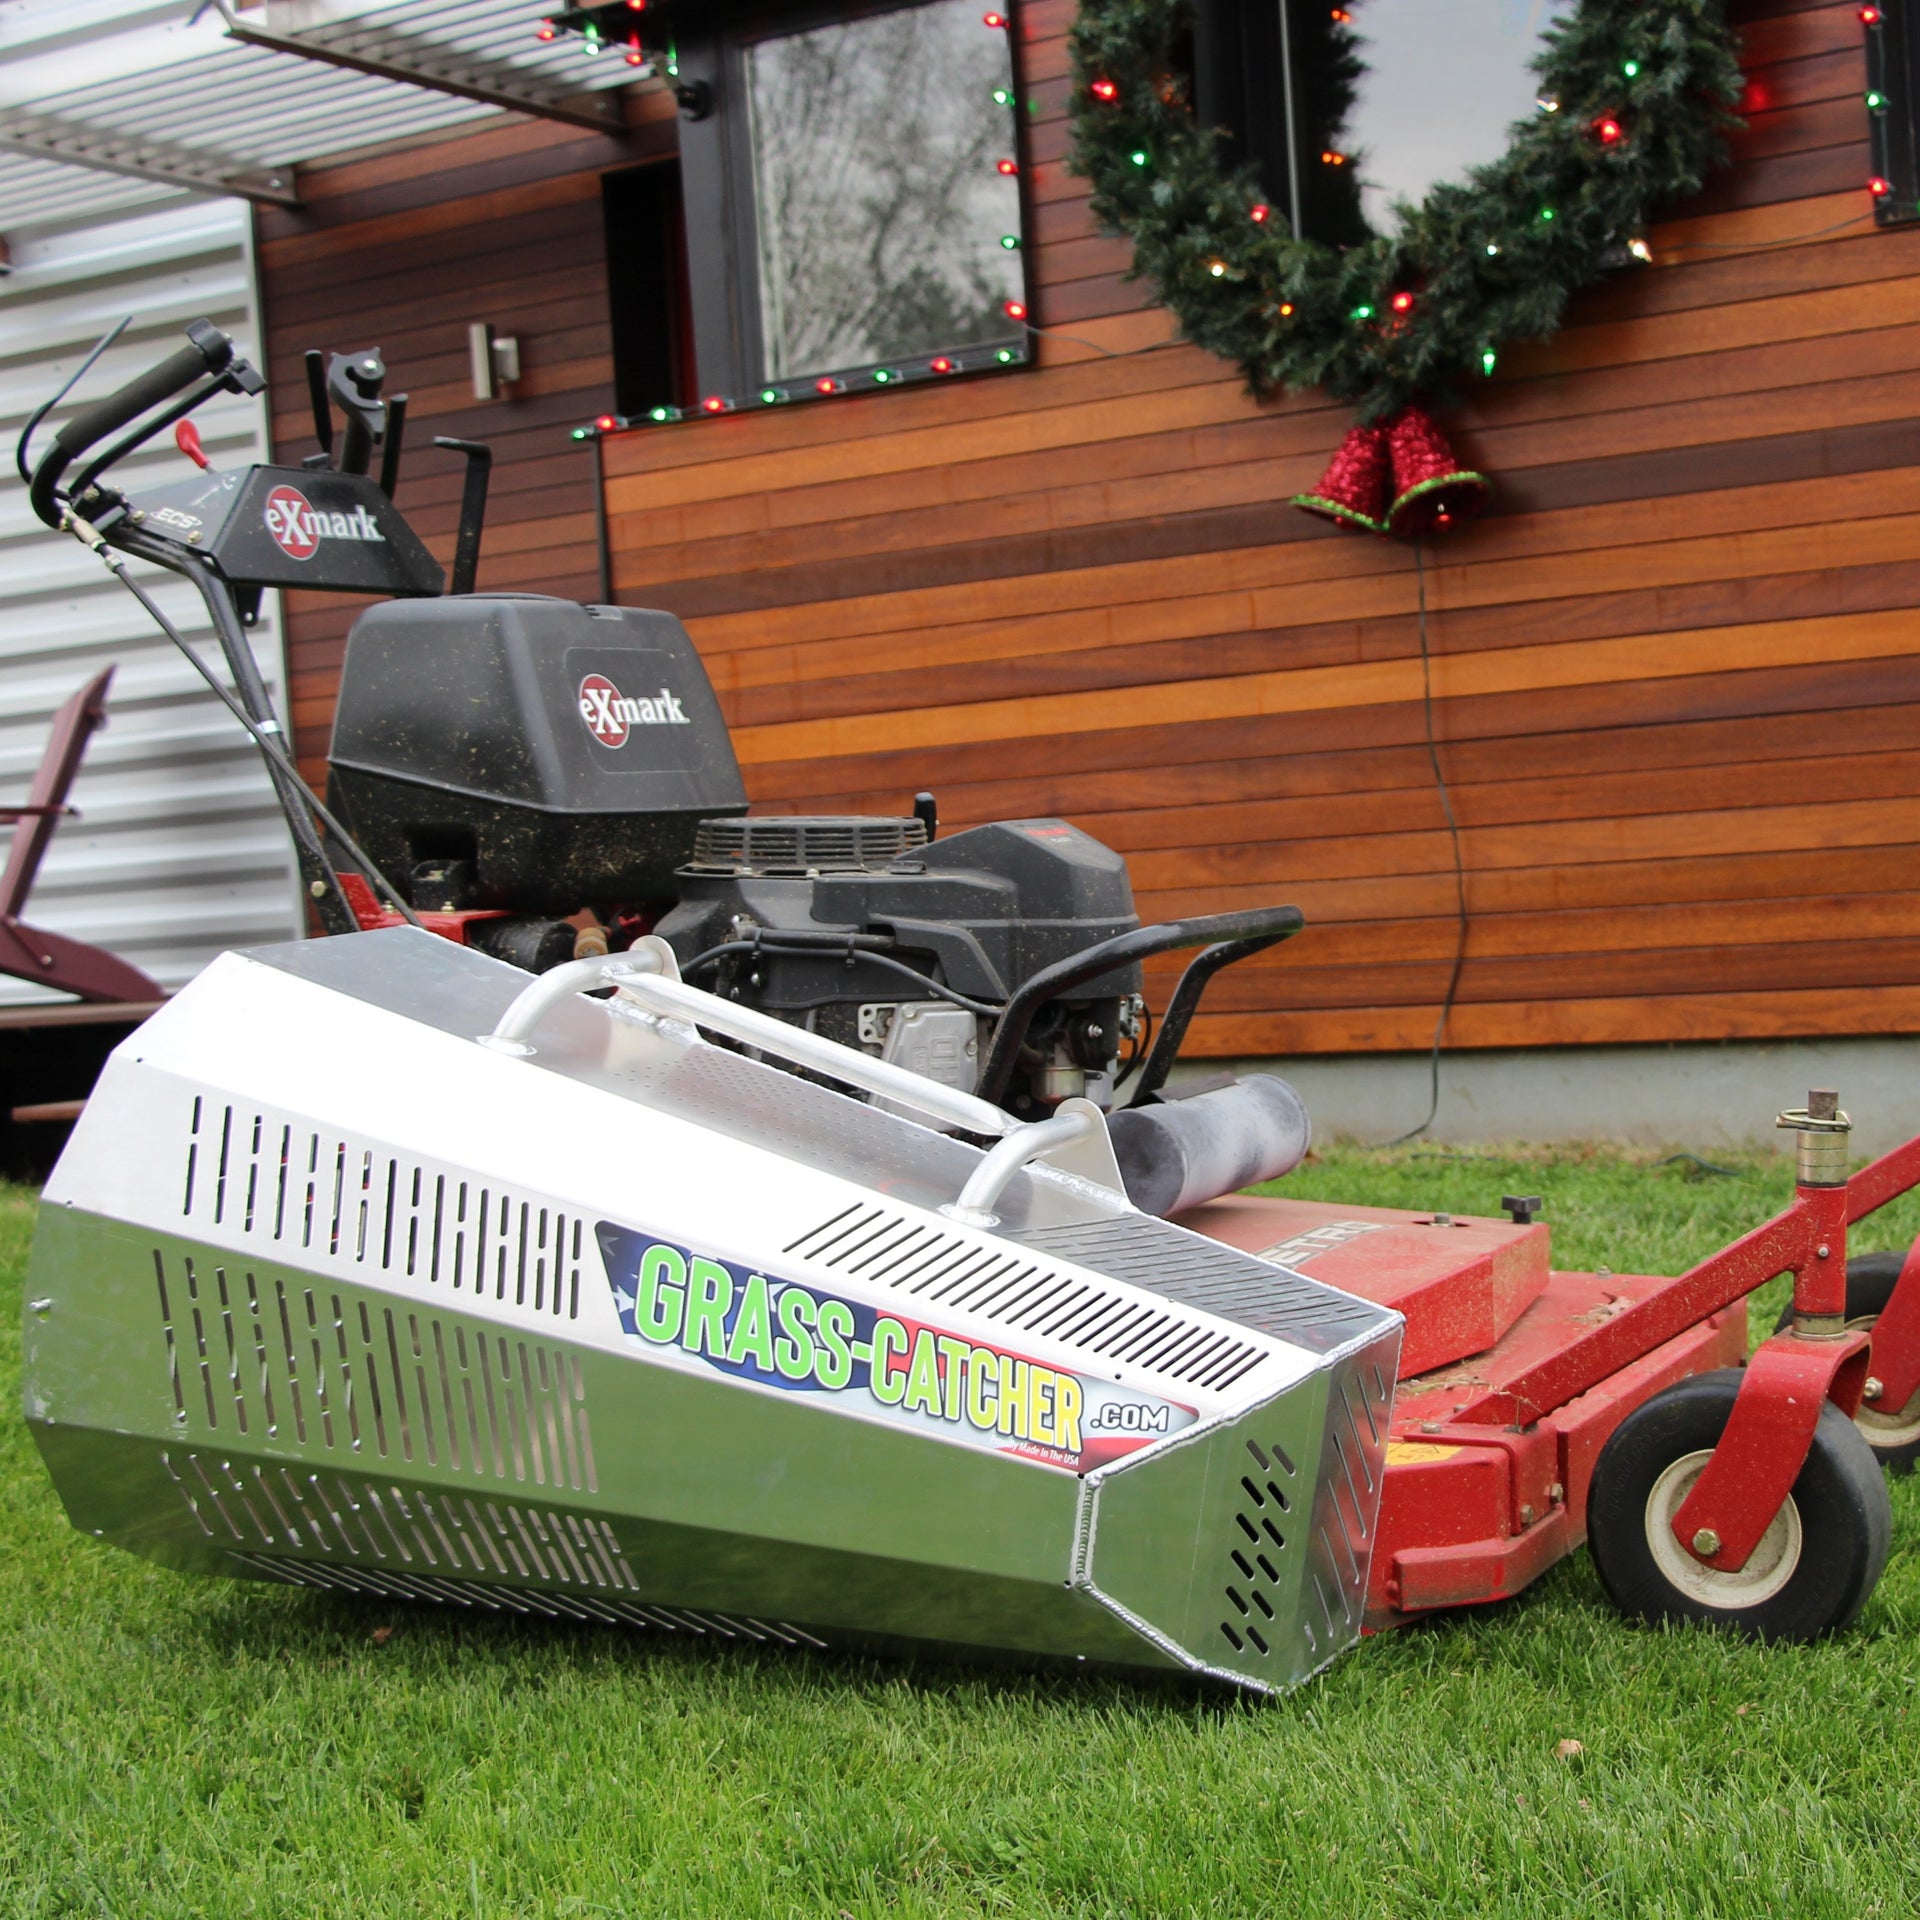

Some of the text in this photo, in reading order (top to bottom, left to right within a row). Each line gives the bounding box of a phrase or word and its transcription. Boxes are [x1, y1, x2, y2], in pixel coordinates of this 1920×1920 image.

[153, 507, 201, 529] ECS
[1256, 1221, 1384, 1265] ETRO
[634, 1243, 1169, 1453] GRASS-CATCHER .COM
[990, 1434, 1080, 1466] Proudly Made In The USA
